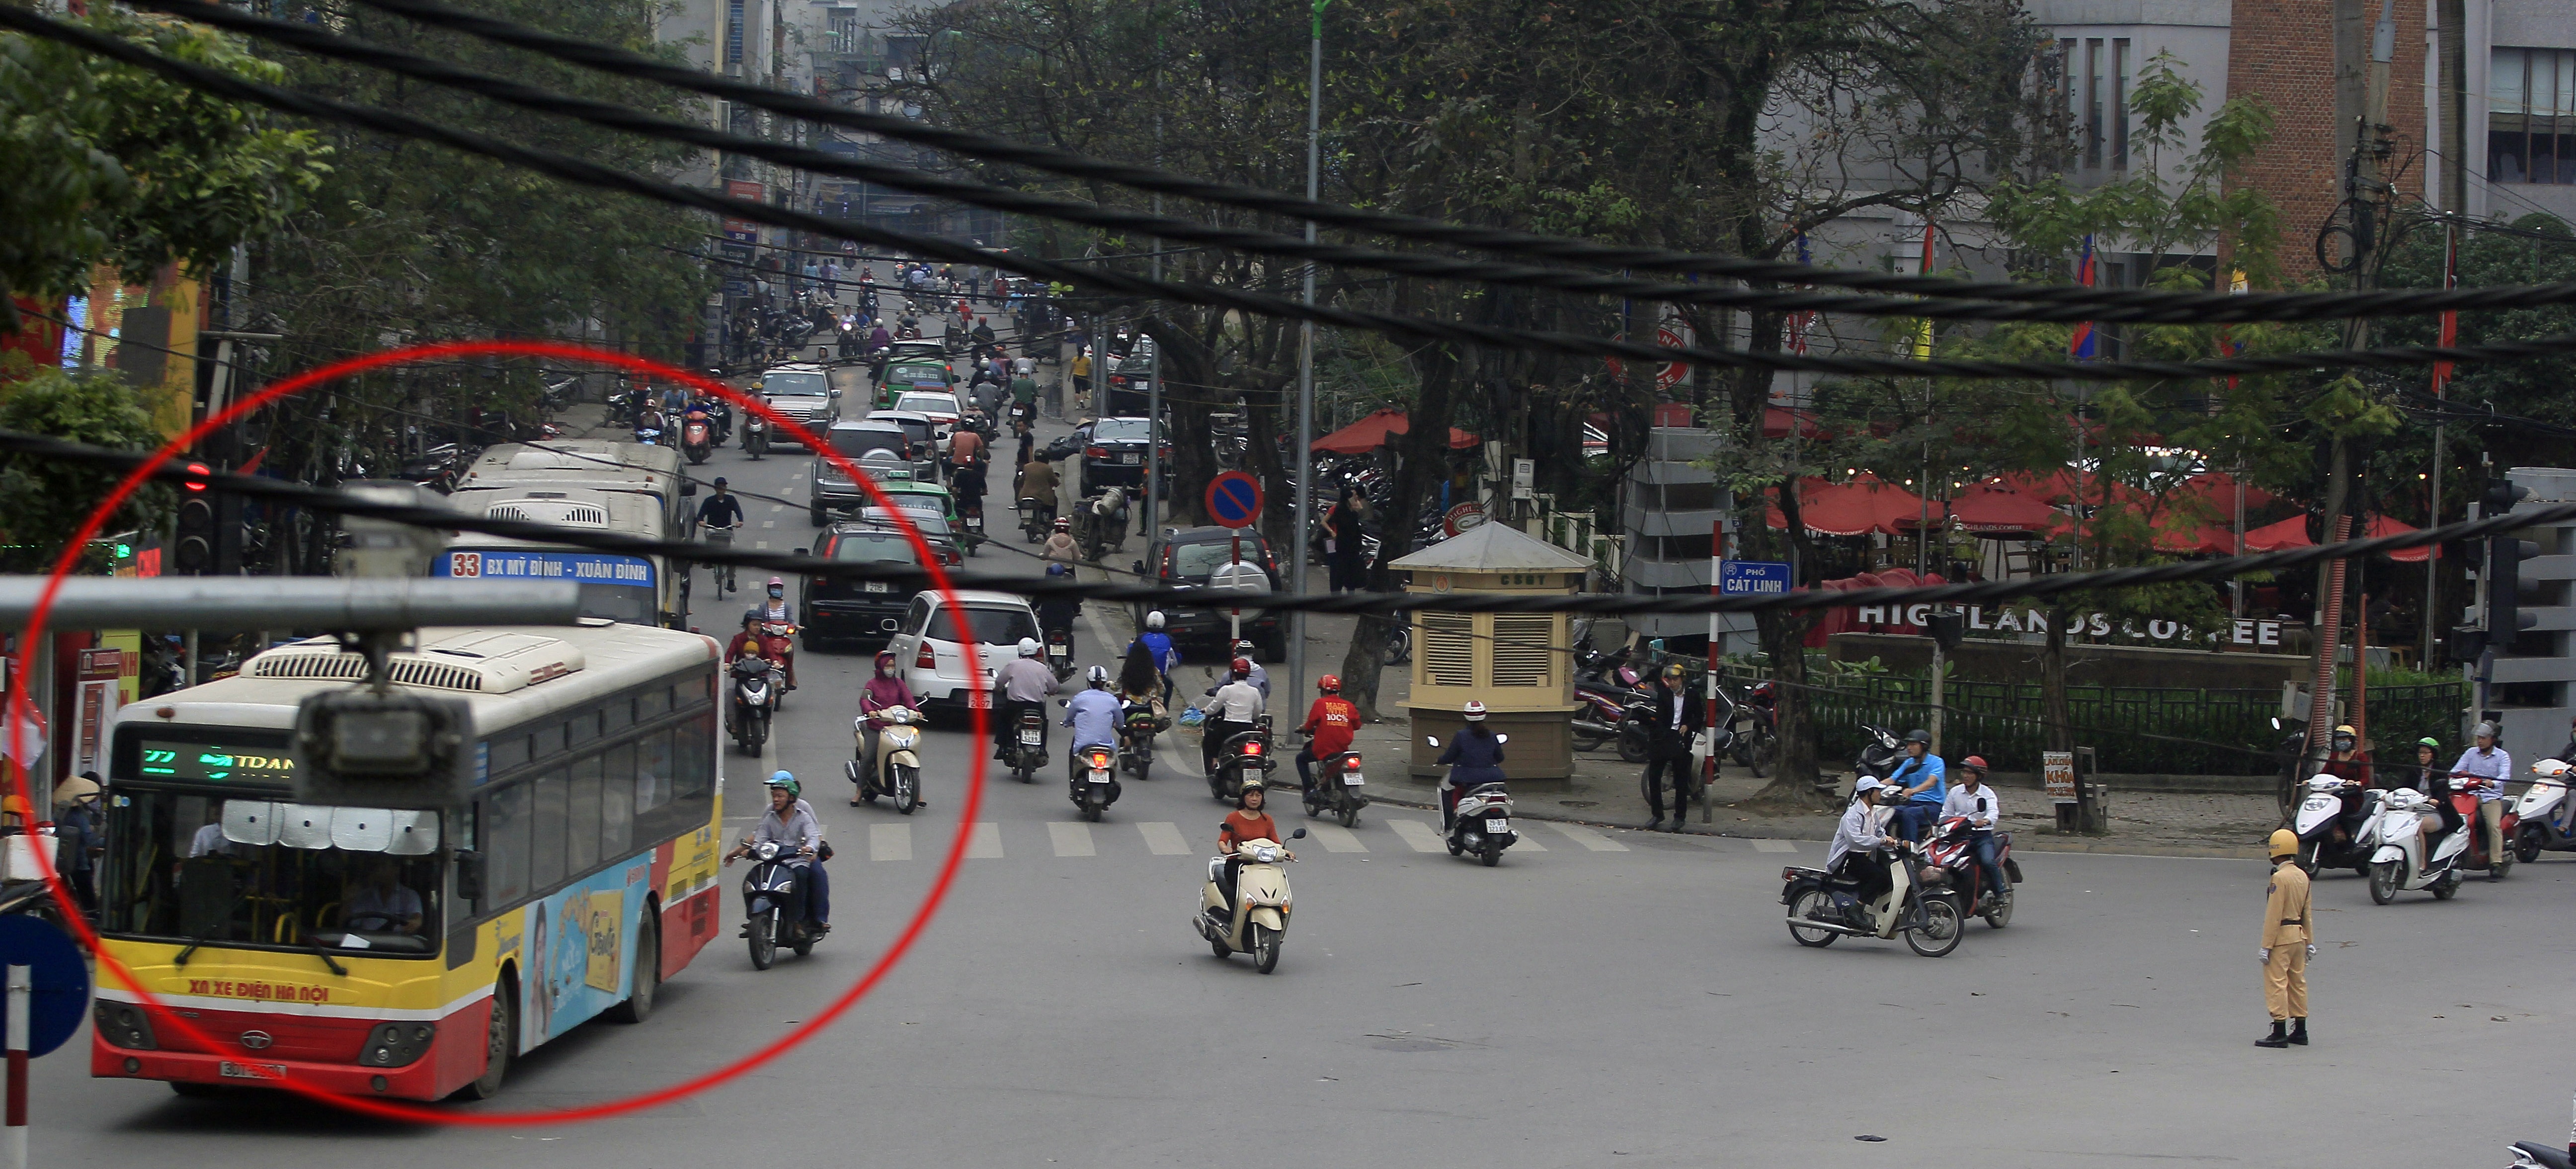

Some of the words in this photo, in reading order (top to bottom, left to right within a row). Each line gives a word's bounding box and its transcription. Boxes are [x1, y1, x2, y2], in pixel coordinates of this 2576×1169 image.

[454, 553, 480, 577] 33
[486, 559, 504, 575] BX
[507, 556, 526, 576] MỸ
[529, 557, 563, 577] ĐÌNH
[575, 559, 612, 579] XUÂN
[1746, 567, 1766, 576] PHỐ
[1727, 576, 1751, 591] CÁT
[1754, 580, 1782, 592] LINH
[187, 979, 210, 994] XN
[214, 981, 233, 996] XE
[237, 980, 272, 1003] ĐIỆN
[275, 982, 296, 1000] HÀ
[300, 984, 329, 1006] NỘI
